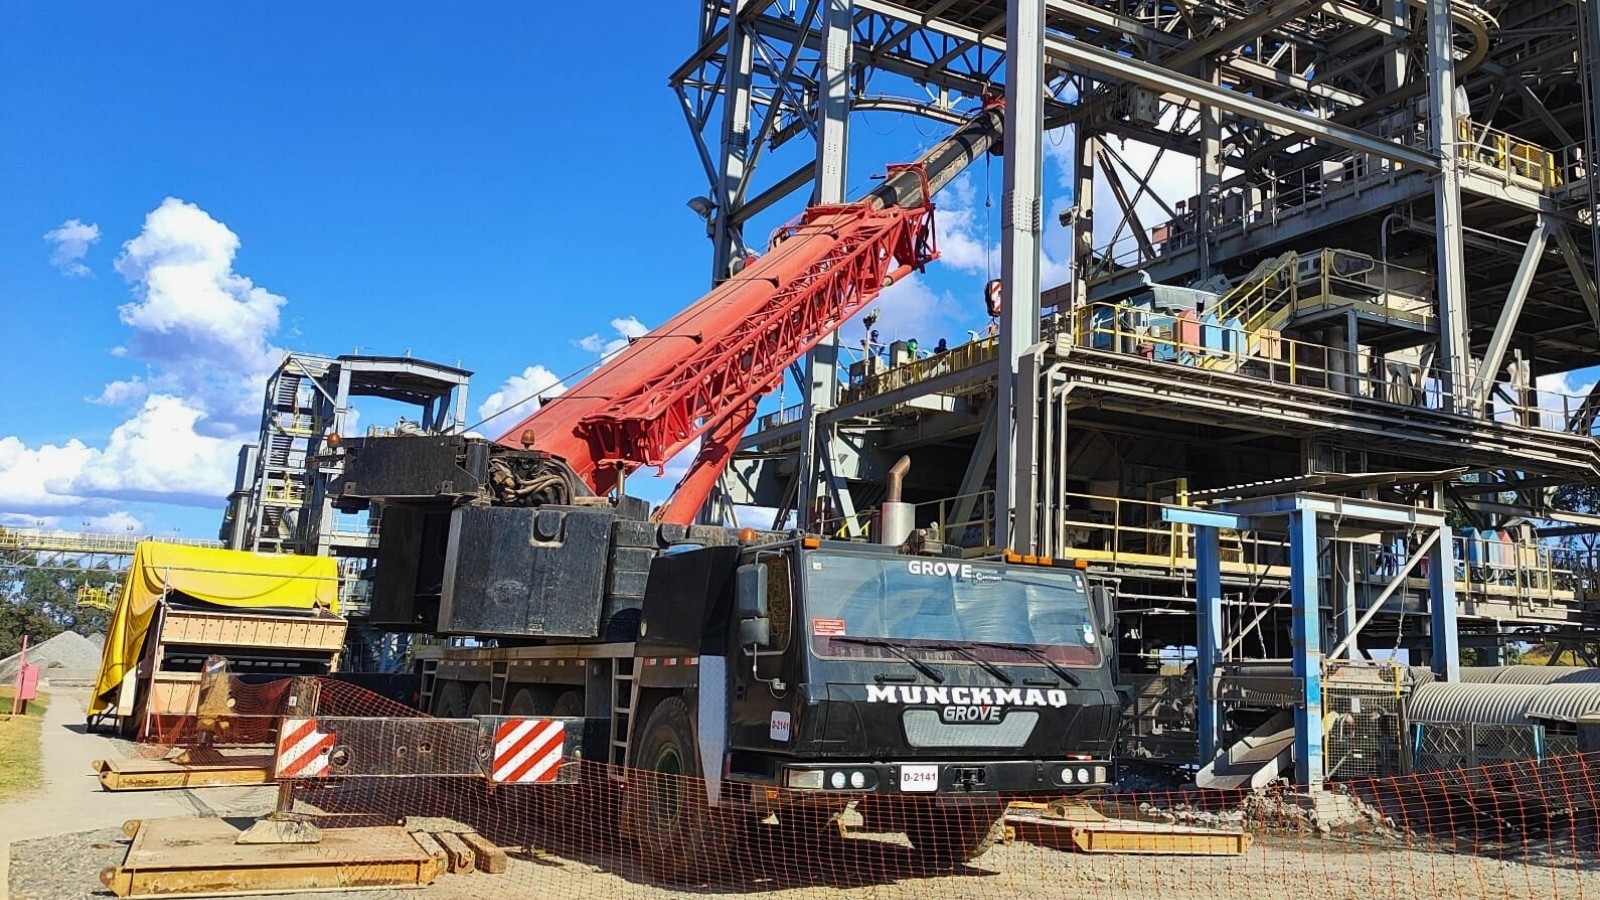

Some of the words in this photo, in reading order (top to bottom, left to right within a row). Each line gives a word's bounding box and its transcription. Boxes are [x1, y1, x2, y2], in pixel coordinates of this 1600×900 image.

[908, 560, 972, 578] GROVE
[866, 685, 1067, 708] MUNCKMAQ
[943, 705, 1001, 721] GROVE
[903, 772, 936, 781] D-2141
